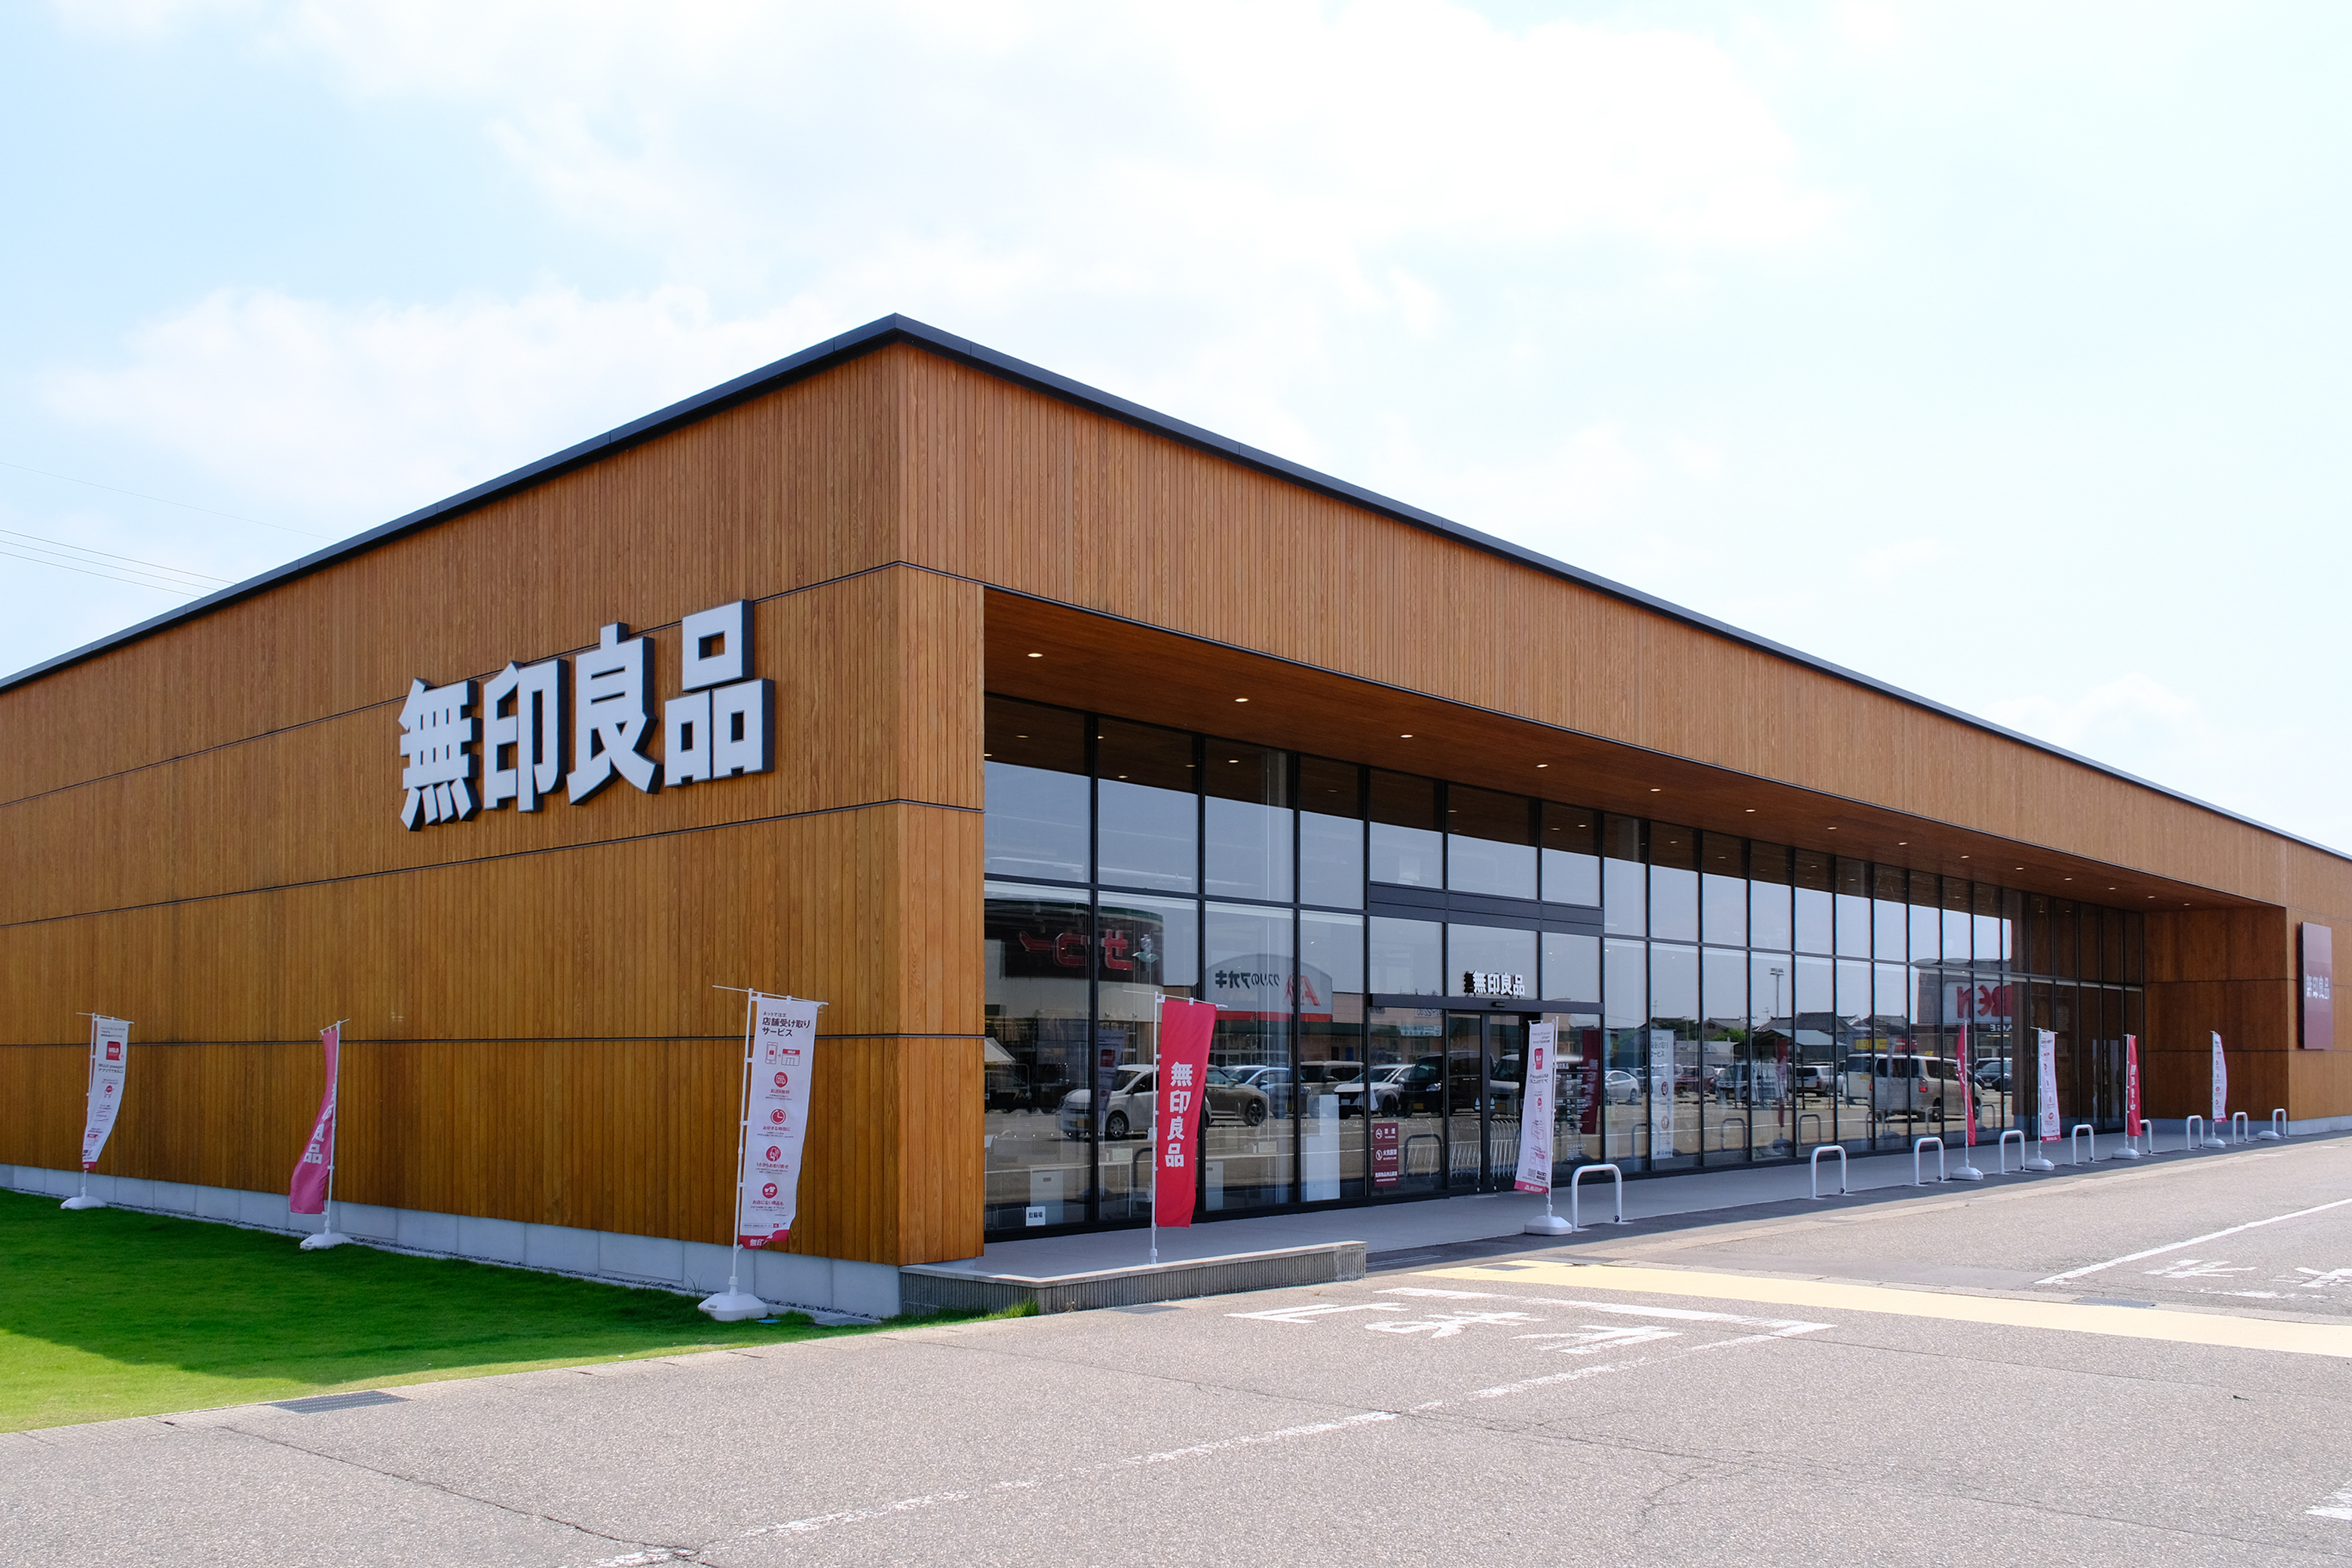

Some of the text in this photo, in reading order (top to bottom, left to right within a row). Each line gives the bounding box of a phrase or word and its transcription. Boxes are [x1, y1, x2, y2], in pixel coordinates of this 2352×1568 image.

[399, 599, 774, 831] 無印良品
[1472, 970, 1526, 996] 無印良品
[2306, 974, 2330, 1000] 無印良品
[762, 1017, 810, 1028] 店舗受け取り
[762, 1027, 793, 1037] サービス
[1165, 1061, 1193, 1167] 無印良品
